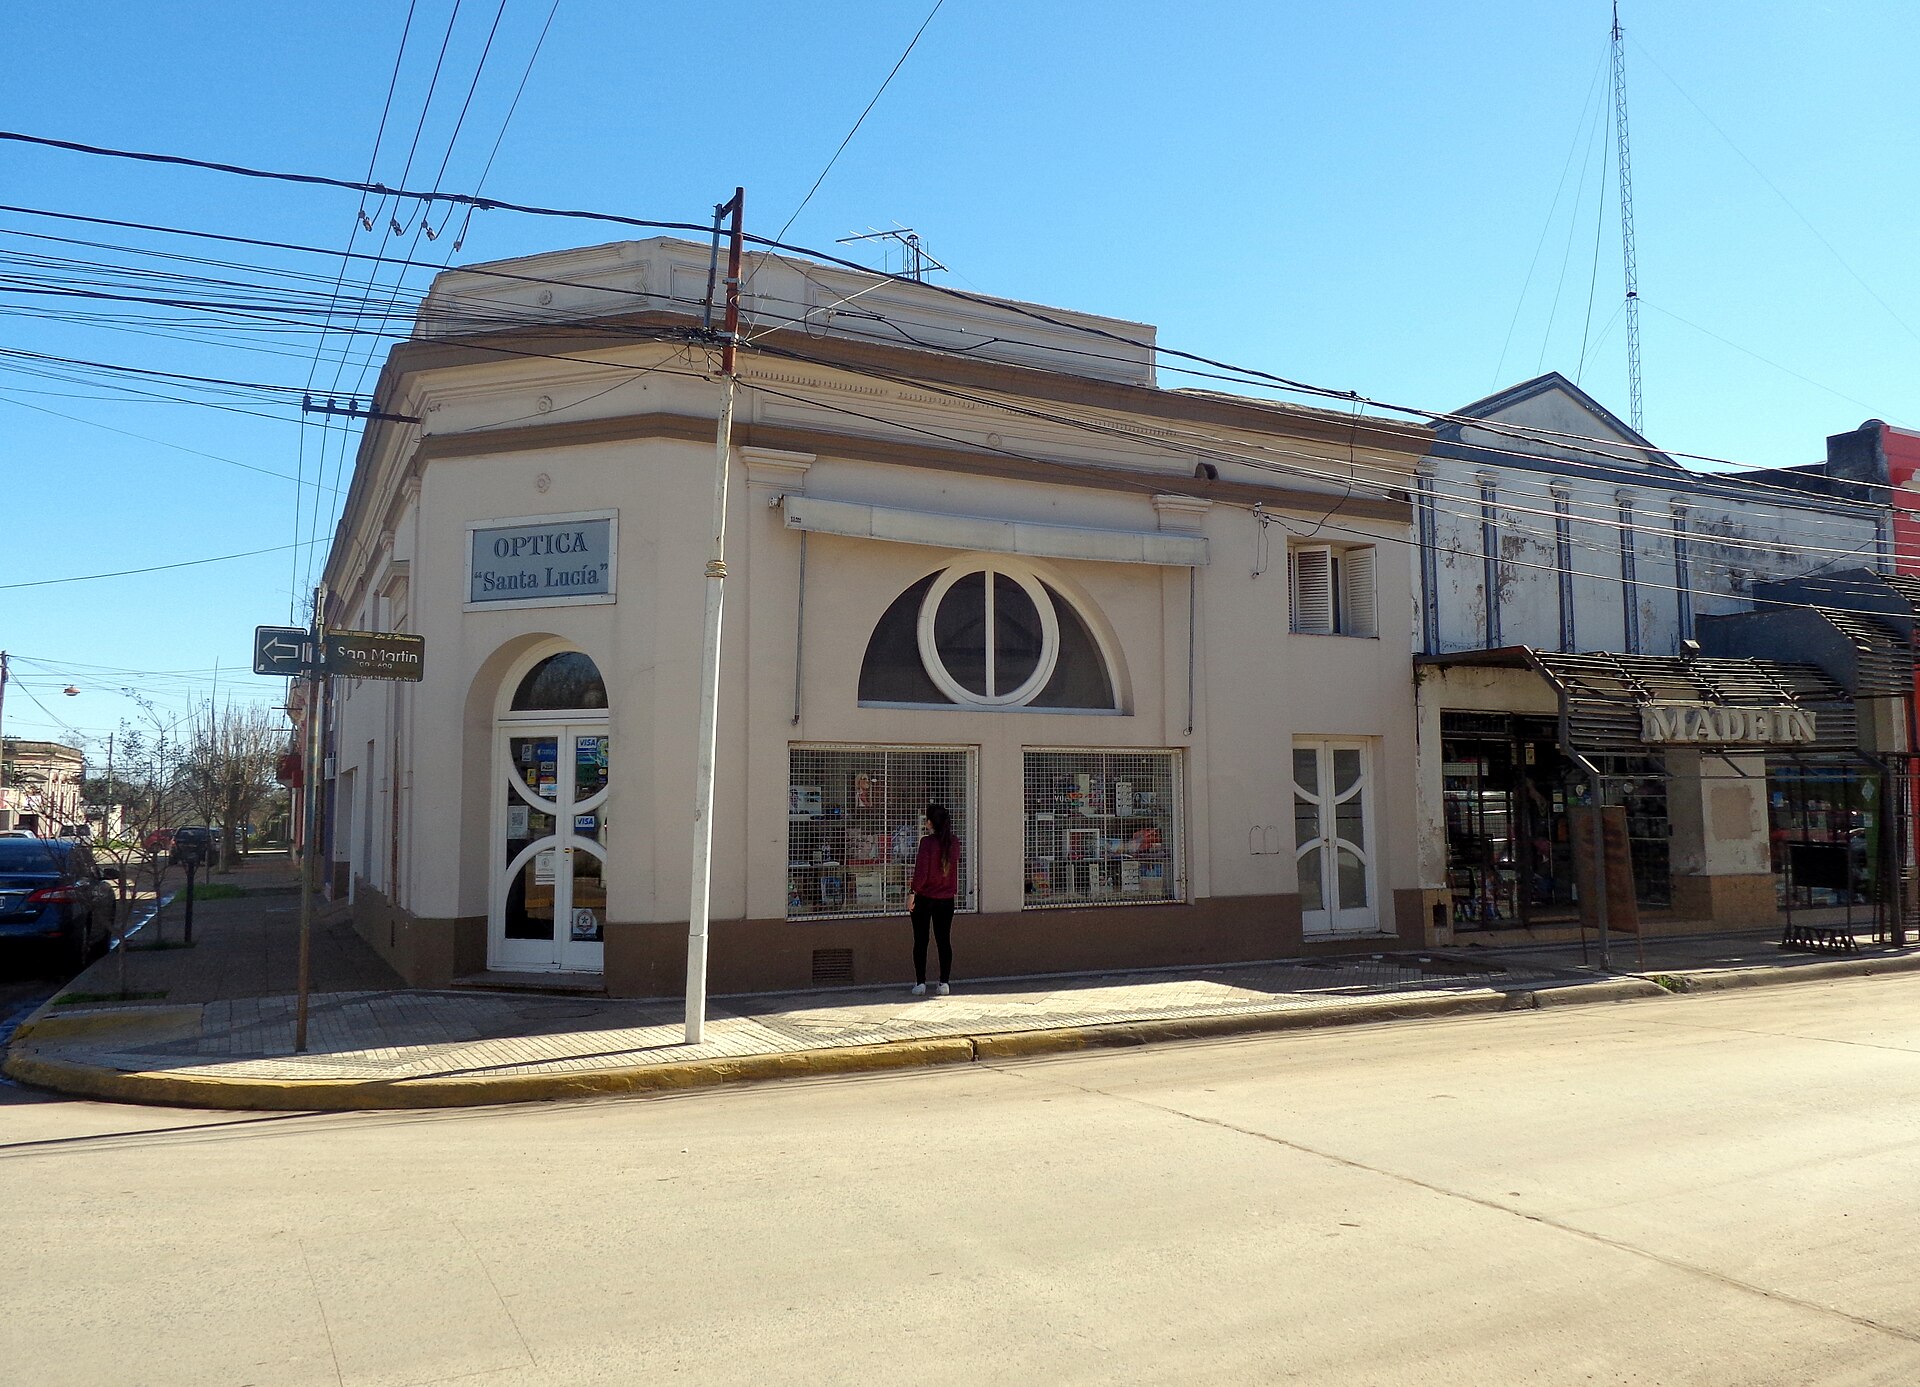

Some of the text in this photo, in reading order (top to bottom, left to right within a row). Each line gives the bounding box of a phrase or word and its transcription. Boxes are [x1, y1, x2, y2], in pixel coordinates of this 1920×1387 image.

[494, 532, 588, 558] OPTICA
[338, 646, 418, 663] San Martin
[579, 738, 596, 746] VISA
